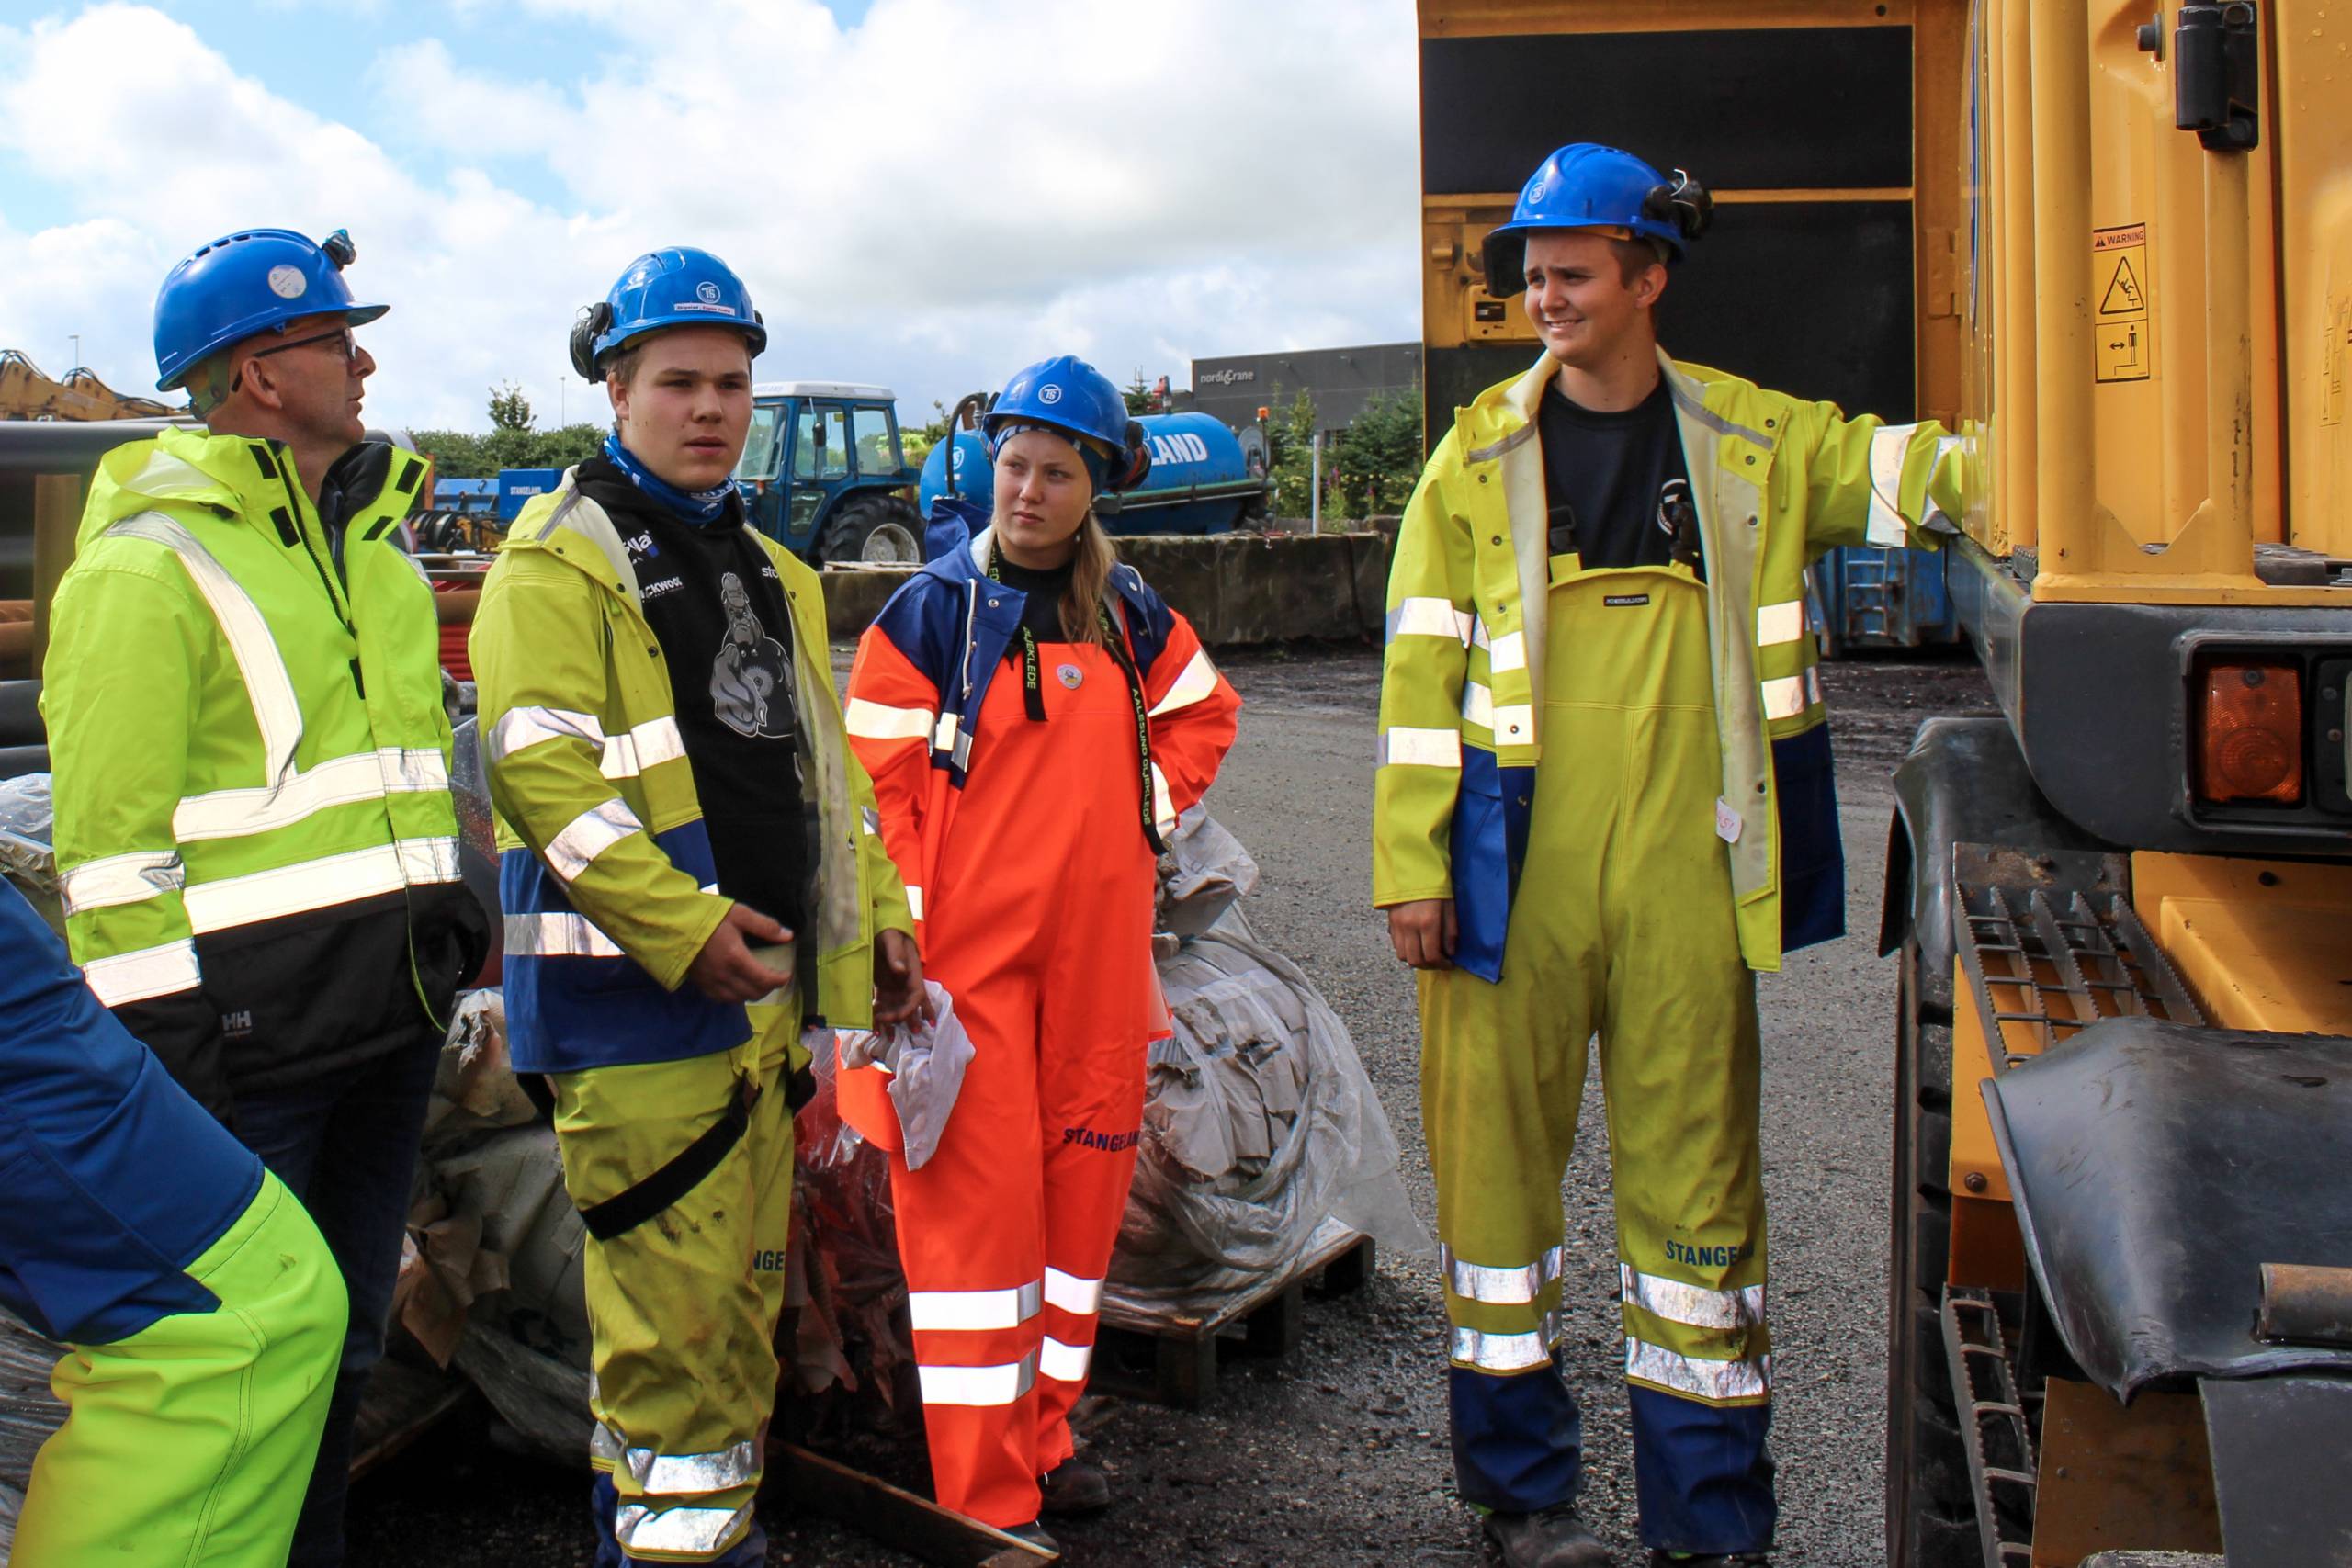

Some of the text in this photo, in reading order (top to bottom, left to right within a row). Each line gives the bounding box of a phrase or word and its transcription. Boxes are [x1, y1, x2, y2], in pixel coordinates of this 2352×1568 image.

[2107, 231, 2144, 245] WARNING
[701, 285, 718, 299] TS
[1044, 389, 1060, 400] TS
[1132, 688, 1148, 756] AALESUND
[222, 1010, 253, 1032] HH
